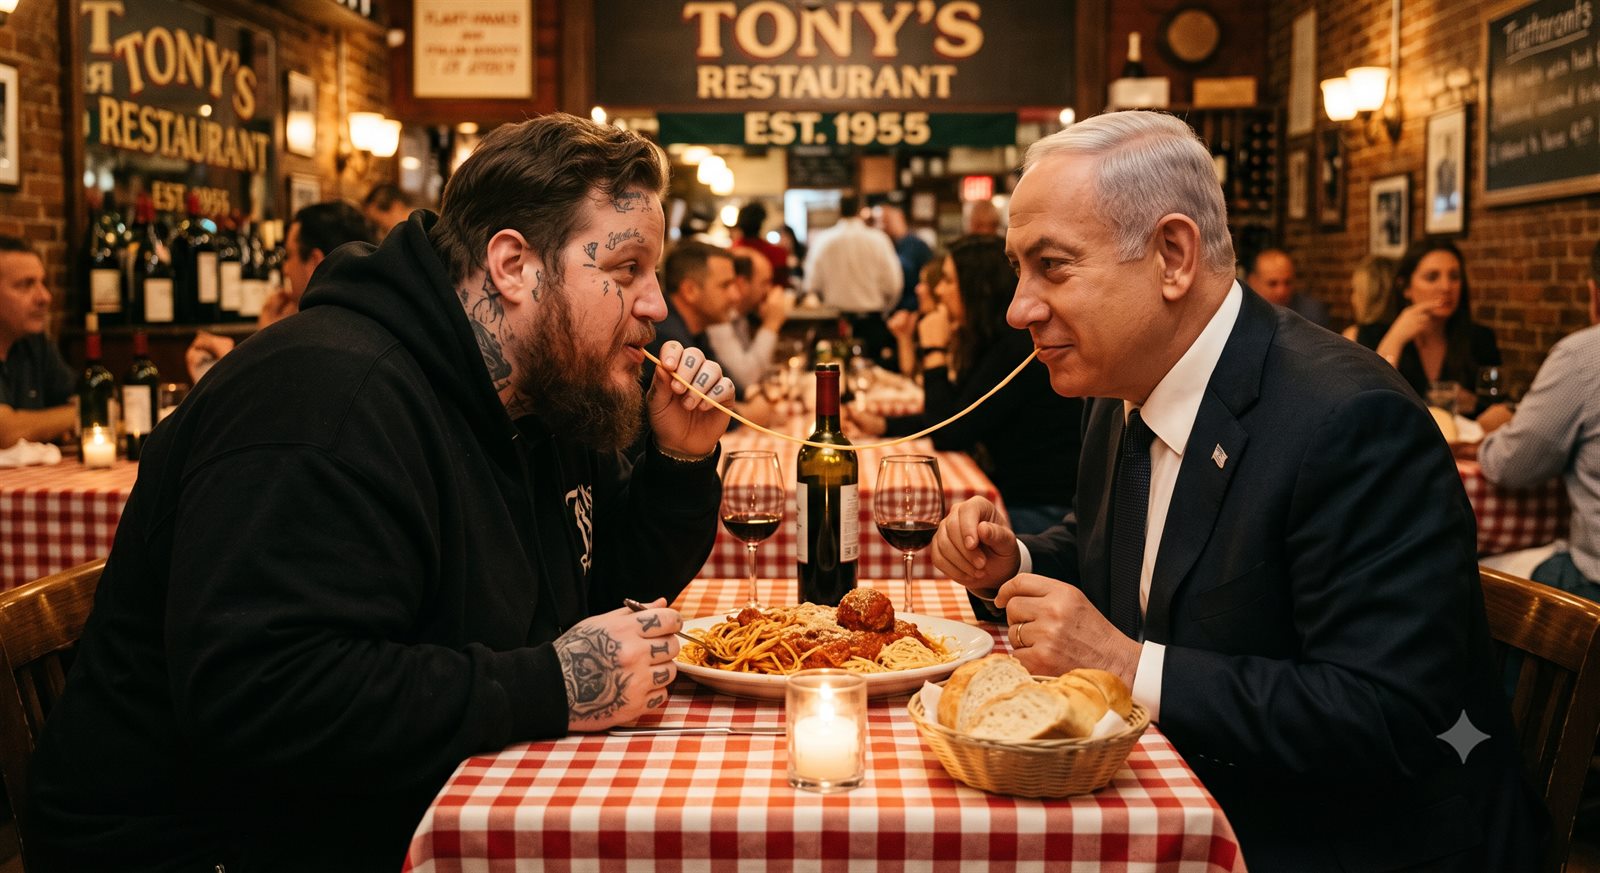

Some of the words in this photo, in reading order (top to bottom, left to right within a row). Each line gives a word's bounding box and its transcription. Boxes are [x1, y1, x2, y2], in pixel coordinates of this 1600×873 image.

[684, 1, 985, 58] TONY'S
[113, 26, 256, 120] TONY'S
[697, 64, 957, 99] RESTAURANT
[99, 95, 270, 172] RESTAURANT
[744, 111, 827, 145] EST.
[834, 112, 931, 145] 1955
